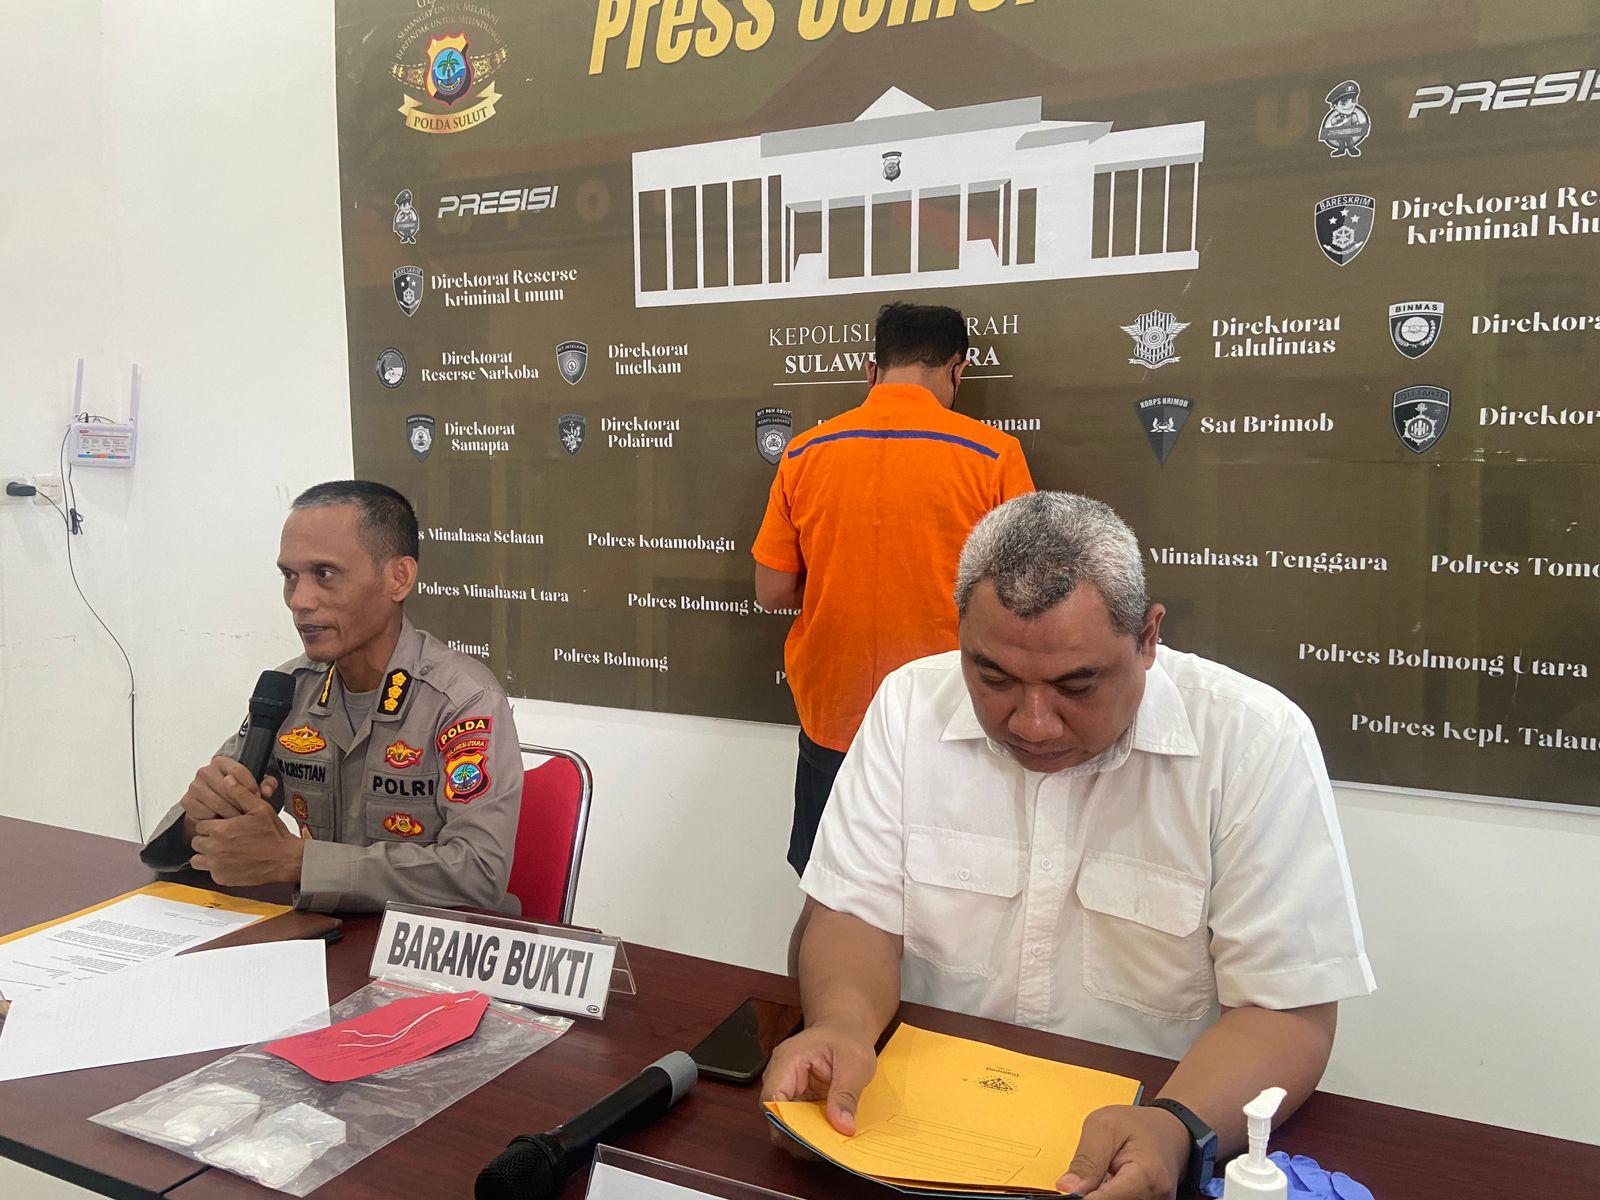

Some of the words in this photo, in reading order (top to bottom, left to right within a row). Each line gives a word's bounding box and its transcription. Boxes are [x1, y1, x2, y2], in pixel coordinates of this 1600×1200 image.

[589, 0, 775, 75] Press
[414, 116, 451, 130] POLDA
[453, 107, 488, 129] SULUT
[437, 185, 559, 219] PRESISI
[1320, 196, 1371, 210] BARESKRIM
[1392, 190, 1547, 220] Direktorat
[1408, 214, 1538, 245] Kriminal
[431, 272, 509, 290] Direktorat
[513, 268, 578, 285] Reserse
[445, 288, 510, 307] Kriminal
[514, 288, 564, 303] Umum
[1395, 302, 1438, 313] BINMAS
[769, 323, 876, 346] KEPOLISI
[966, 314, 1019, 336] RAH
[1212, 314, 1341, 337] Direktorat
[442, 350, 512, 365] Direktorat
[609, 342, 688, 359] Direktorat
[1214, 337, 1336, 358] Lalulintas
[421, 367, 476, 382] Reserse
[479, 364, 539, 381] Narkoba
[615, 359, 681, 375] Intelkam
[1140, 398, 1161, 408] KORPS
[1162, 398, 1188, 407] BRIMOB
[445, 421, 515, 436] Direktorat
[601, 416, 680, 432] Direktorat
[1200, 416, 1236, 434] Sat
[1243, 412, 1334, 433] Brimob
[451, 438, 509, 456] Samapta
[608, 432, 673, 448] Polairud
[428, 527, 490, 543] Minahasa
[493, 529, 544, 545] Selatan
[588, 532, 635, 547] Polres
[639, 534, 735, 554] Kotamobagu
[1149, 546, 1258, 567] Minahasa
[1266, 550, 1388, 574] Tenggara
[1431, 554, 1520, 575] Polres
[418, 581, 460, 596] Polres
[463, 583, 527, 600] Minahasa
[530, 587, 569, 603] Utara
[628, 592, 677, 609] Polres
[680, 595, 749, 616] Bolmong
[554, 648, 600, 664] Polres
[603, 651, 669, 673] Bolmong
[1299, 643, 1380, 665] Polres
[1388, 648, 1505, 677] Bolmong
[1513, 655, 1588, 678] Utara
[441, 719, 486, 745] POLDA
[1351, 714, 1435, 738] Polres
[1443, 721, 1510, 748] Kepl.
[1519, 727, 1600, 751] Talau
[284, 760, 327, 783] KRISTIAN
[372, 775, 434, 796] POLRI
[387, 921, 500, 982] BARANG
[502, 940, 594, 998] BUKTI
